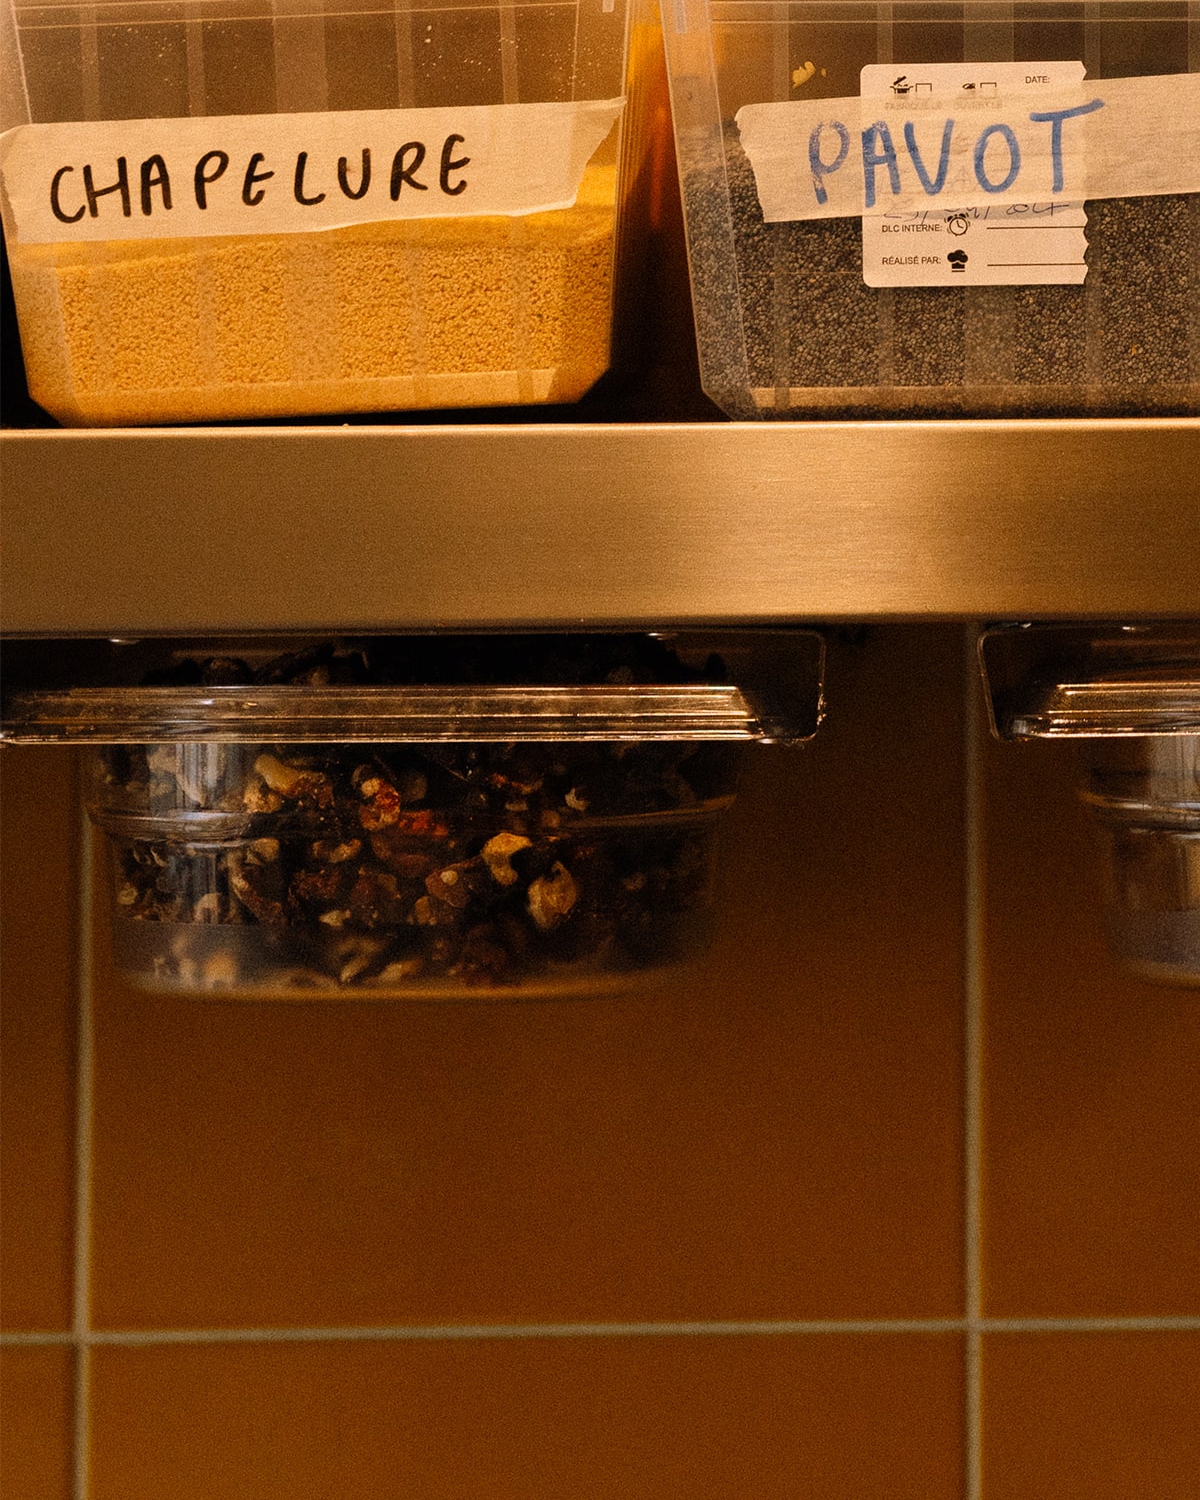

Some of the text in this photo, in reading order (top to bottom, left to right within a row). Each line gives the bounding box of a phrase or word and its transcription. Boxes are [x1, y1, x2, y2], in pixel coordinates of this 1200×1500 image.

[1024, 75, 1051, 85] DATE:
[808, 98, 1105, 208] PAVOT
[51, 133, 472, 224] CHAPELURE
[881, 223, 943, 233] DLC INTERNE:
[881, 255, 942, 265] RÉALISÉ PAR:
